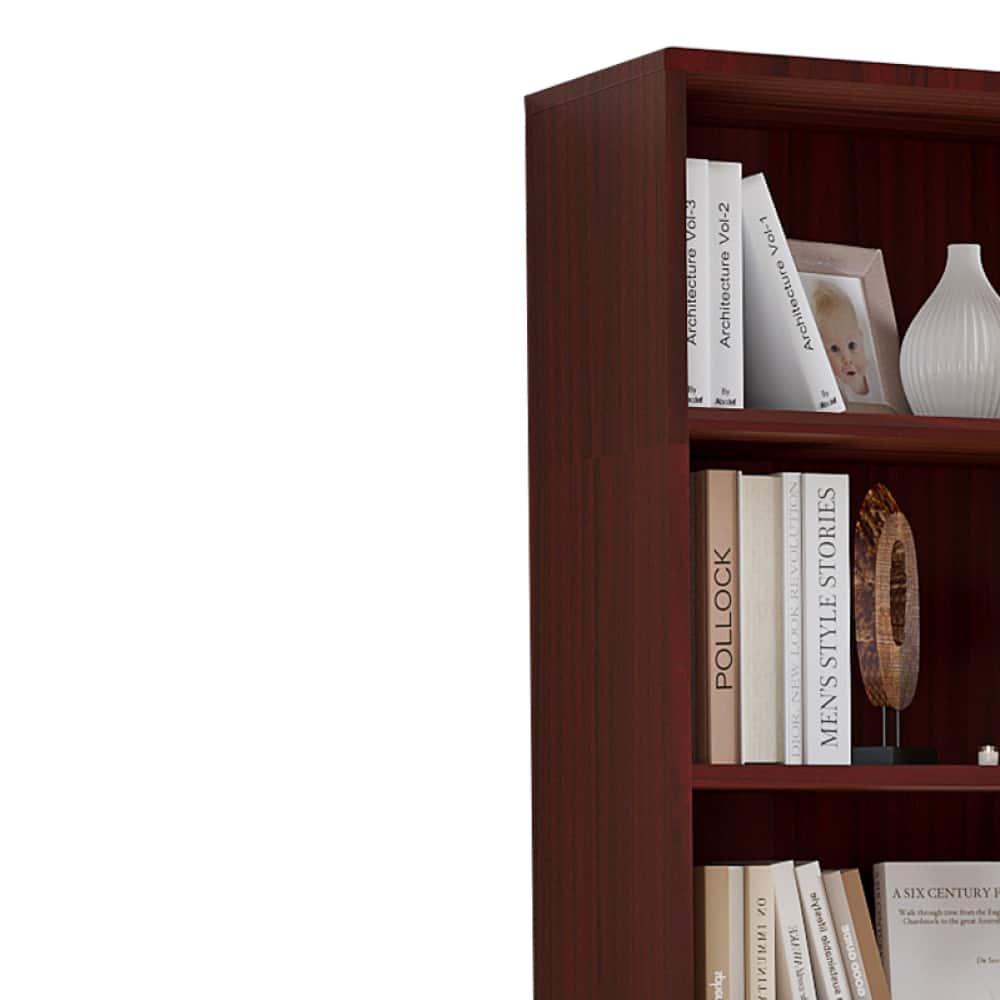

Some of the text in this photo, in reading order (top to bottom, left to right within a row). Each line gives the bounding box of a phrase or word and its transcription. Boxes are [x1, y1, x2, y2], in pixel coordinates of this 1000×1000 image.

[687, 199, 697, 346] Architecture Vol-3
[718, 202, 731, 349] Architecture Vol-2
[759, 215, 815, 351] Architecture Vol-1
[713, 548, 733, 690] POLLOCK
[817, 486, 839, 748] MEN'S STYLE STORIES
[892, 888, 901, 899] A
[904, 887, 925, 899] SIX
[927, 887, 991, 899] CENTURY
